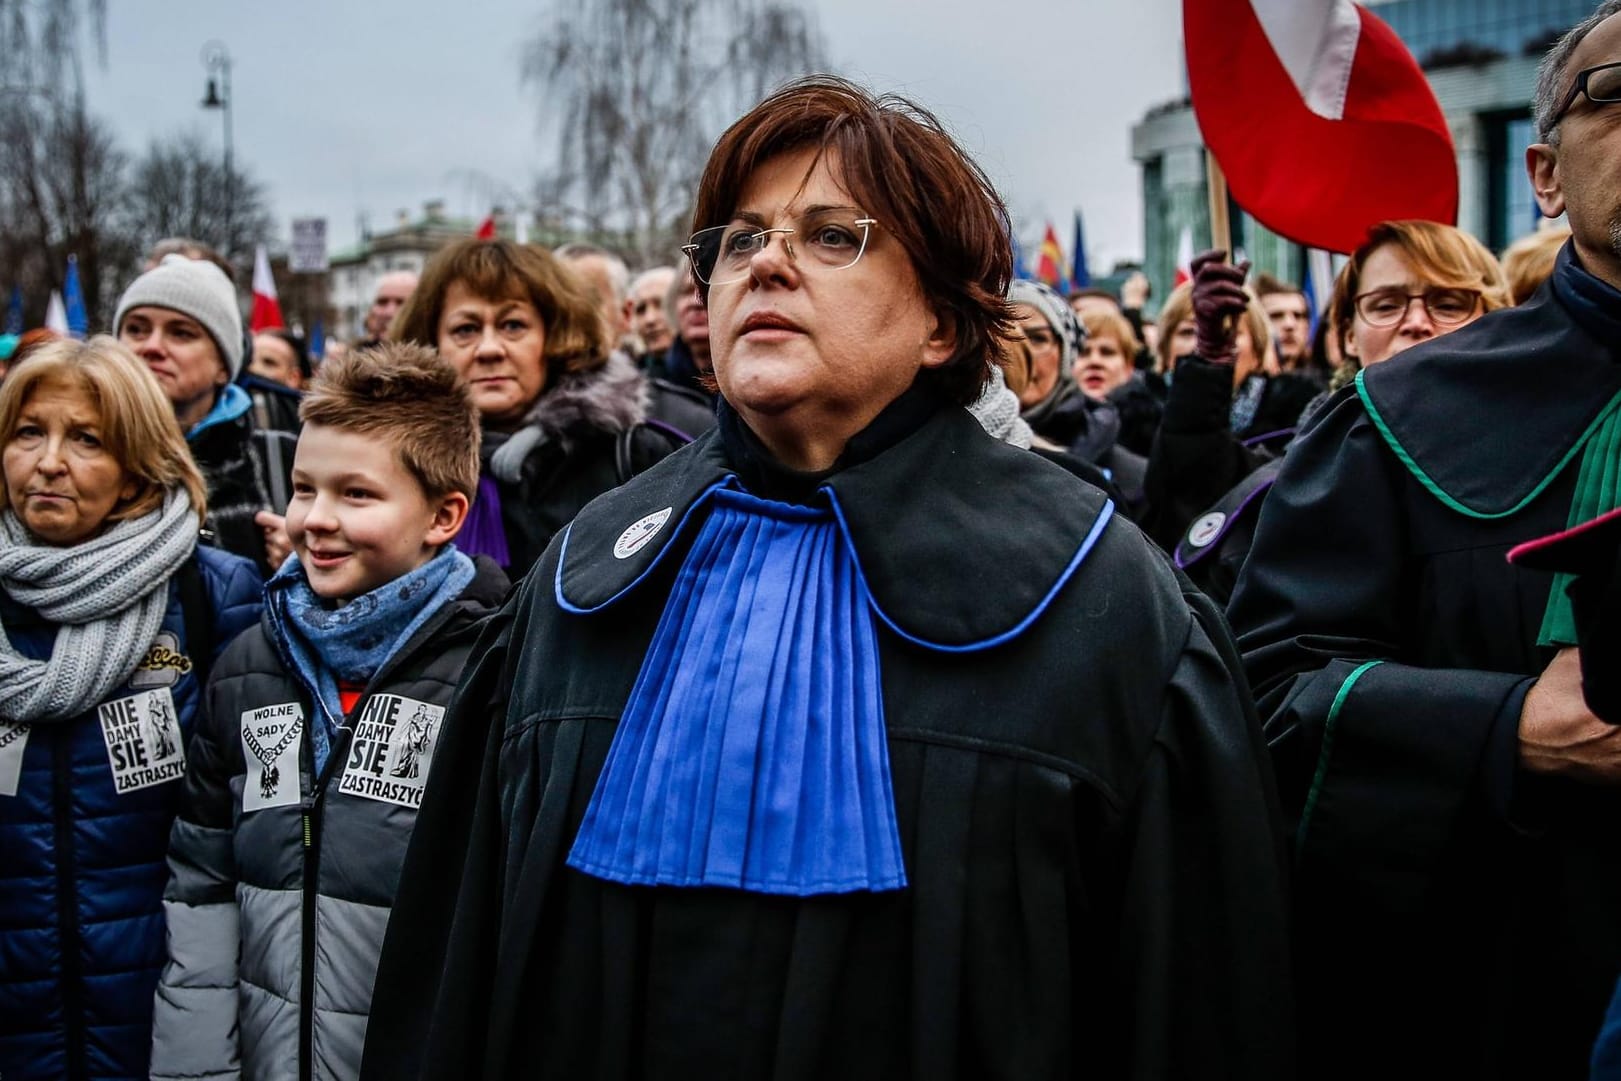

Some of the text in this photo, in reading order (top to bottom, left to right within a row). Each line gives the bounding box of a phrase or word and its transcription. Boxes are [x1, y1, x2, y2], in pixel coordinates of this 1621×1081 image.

[100, 699, 139, 730] NIE
[254, 705, 294, 721] WOLNE
[362, 695, 402, 726] NIE
[106, 724, 140, 745] DAMY
[256, 723, 287, 738] SĄDY
[356, 723, 395, 743] DAMY
[111, 738, 148, 771] SIĘ
[348, 739, 389, 778] SIĘ
[341, 773, 424, 805] ZASTRASZYĆ
